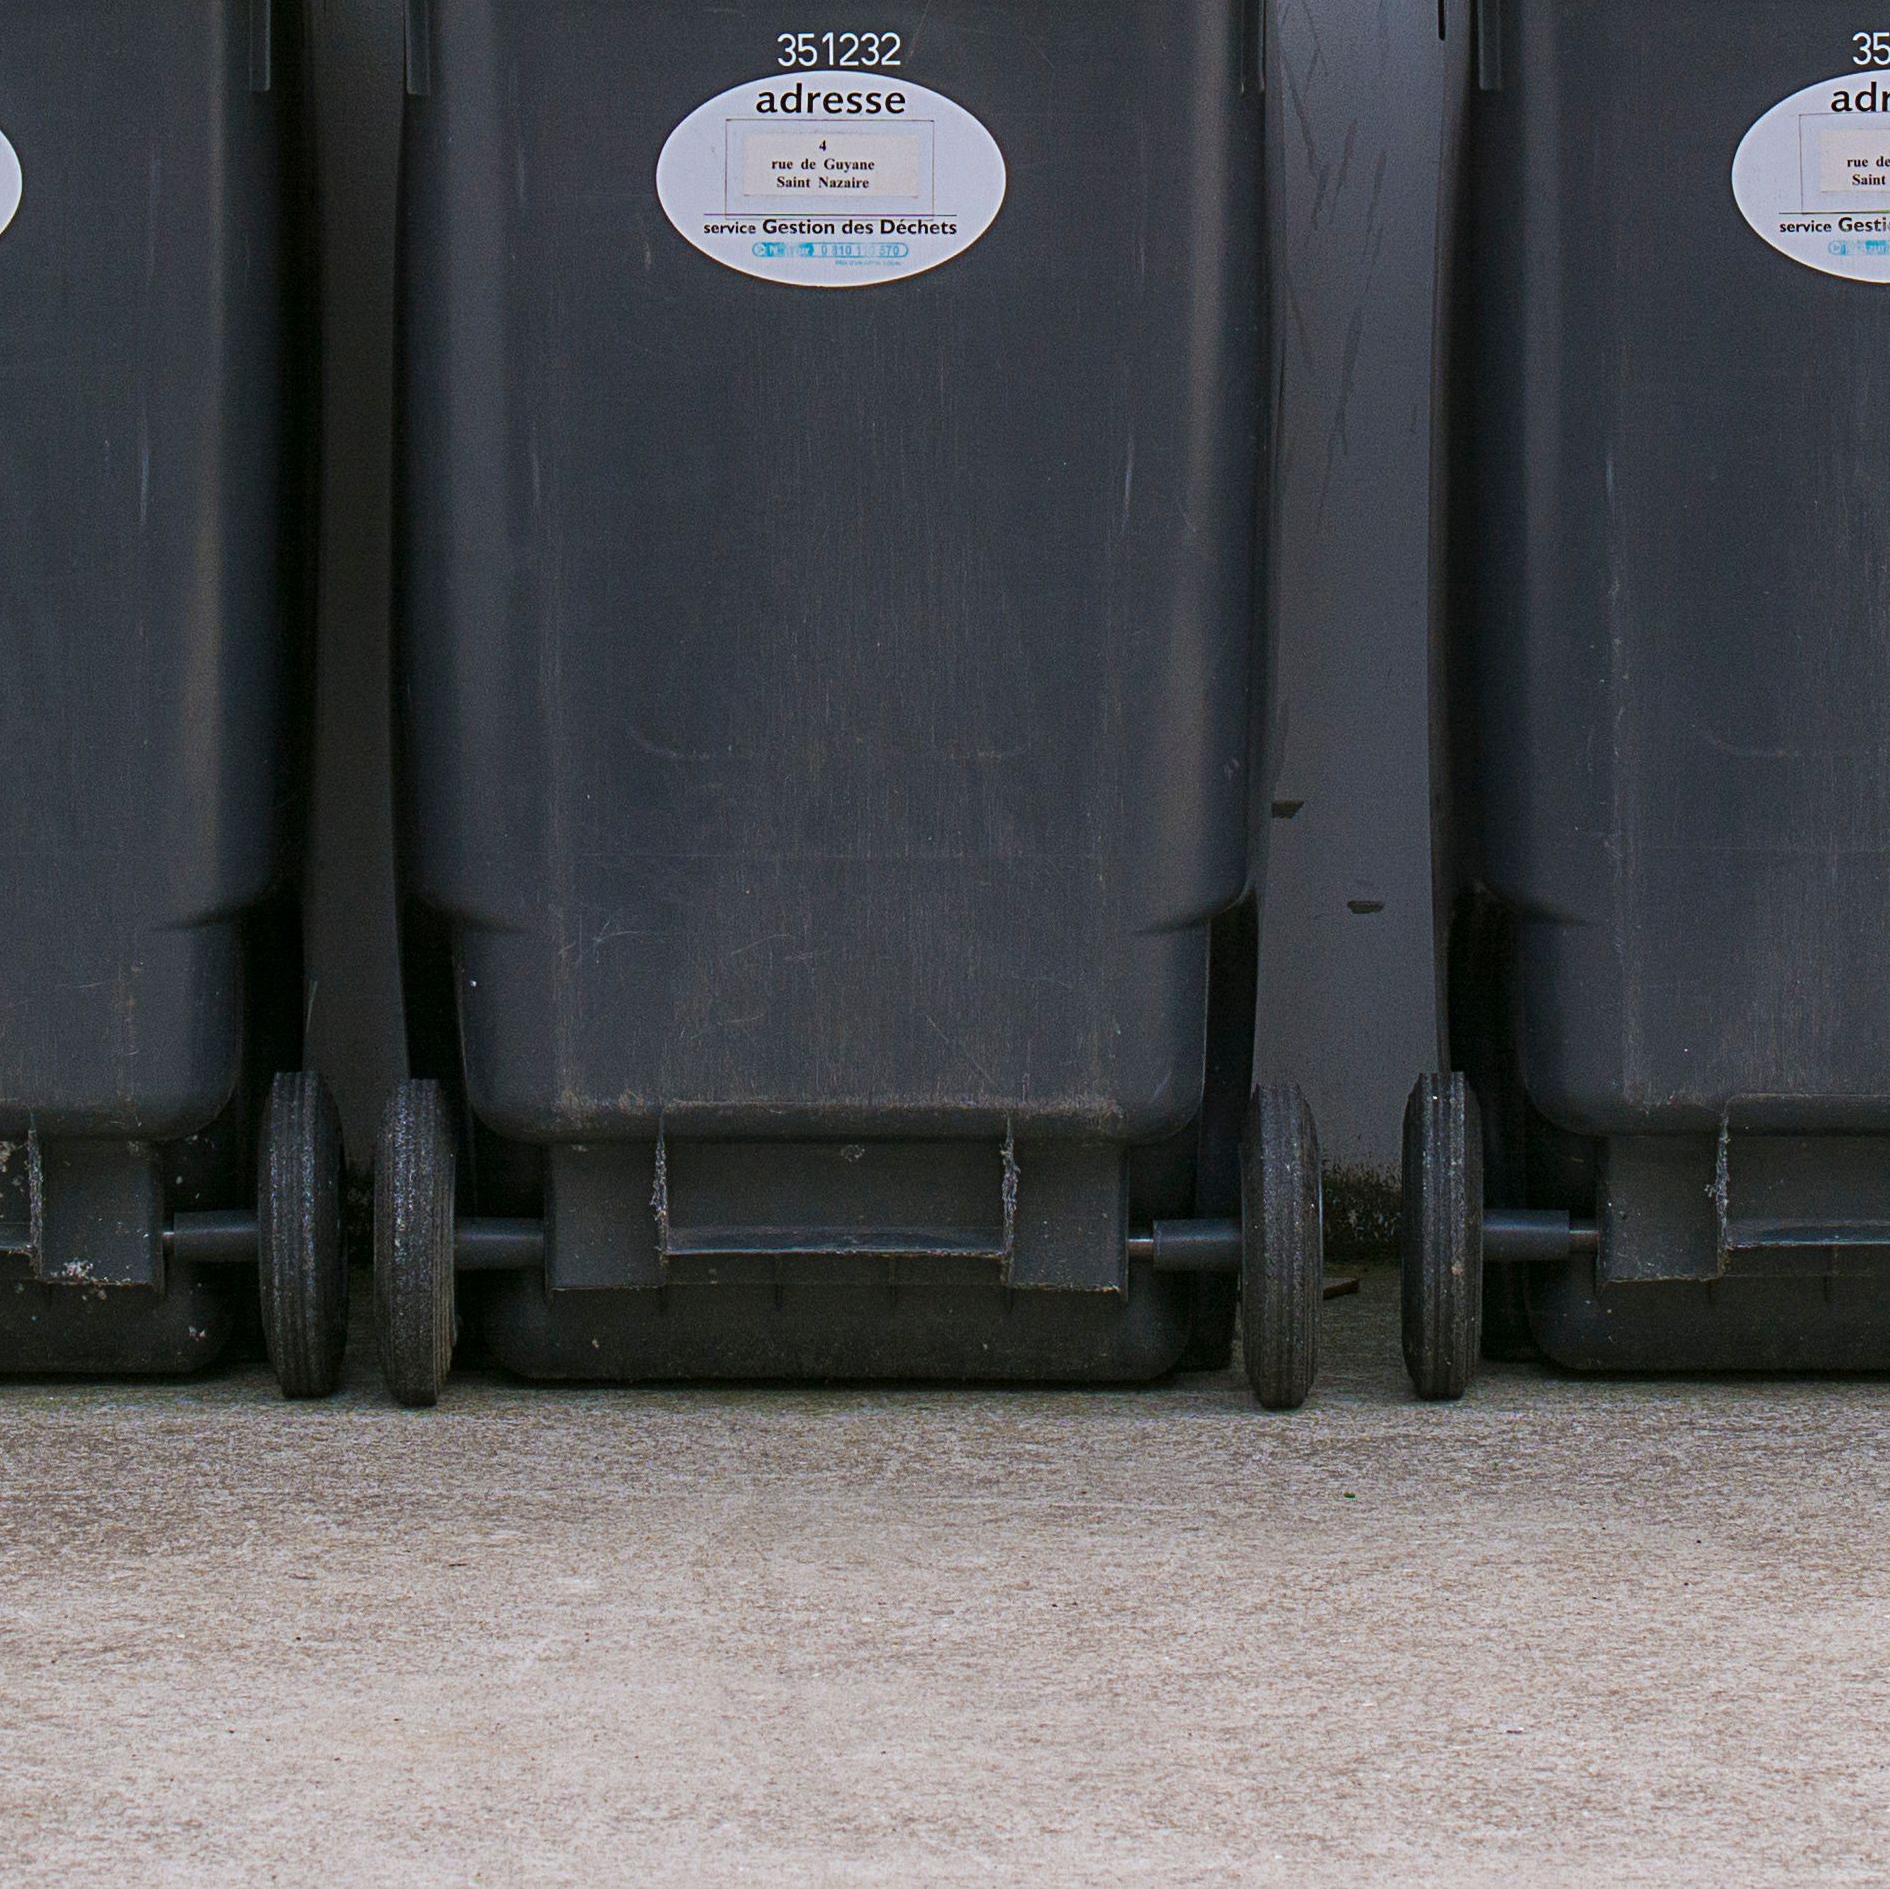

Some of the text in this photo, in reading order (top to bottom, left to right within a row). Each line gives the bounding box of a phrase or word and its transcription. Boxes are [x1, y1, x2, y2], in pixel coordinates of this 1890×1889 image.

[777, 32, 901, 67] 351232
[756, 83, 906, 114] adresse
[819, 140, 827, 152] 4
[771, 158, 875, 173] rue de Guyane
[1847, 158, 1868, 168] rue
[1875, 156, 1890, 167] de
[777, 176, 870, 189] Saint Nazaire
[1852, 173, 1886, 186] Saint
[704, 218, 957, 235] service Gestion des Déchets
[1779, 220, 1832, 233] service
